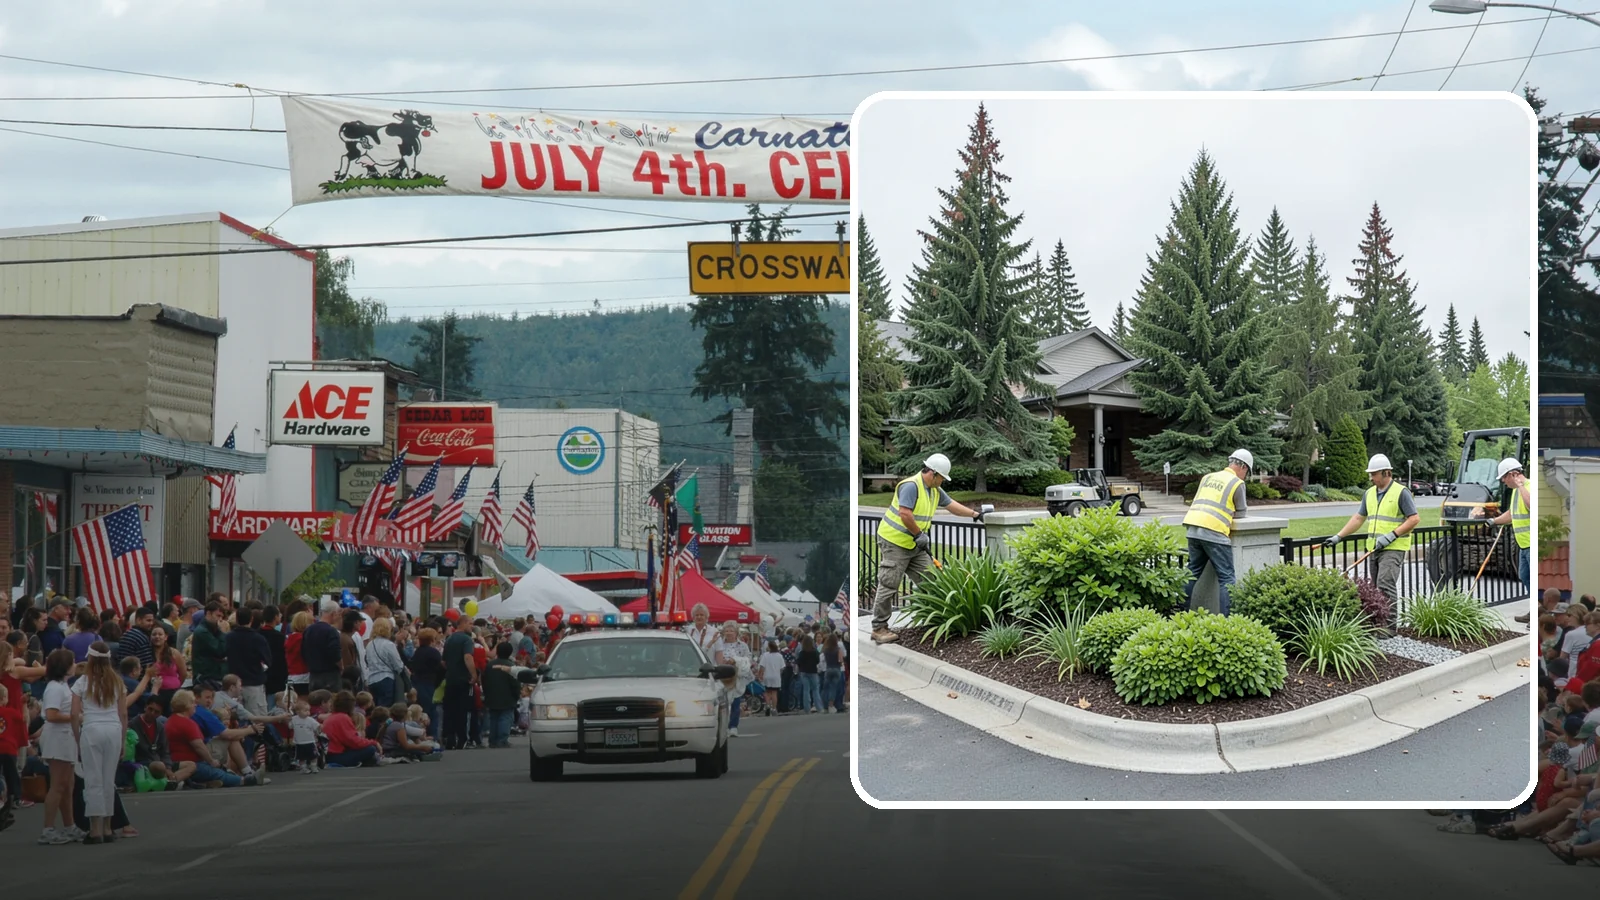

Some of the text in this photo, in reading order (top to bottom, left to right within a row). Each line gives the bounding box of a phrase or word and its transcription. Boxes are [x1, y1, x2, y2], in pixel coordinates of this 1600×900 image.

[695, 121, 850, 150] Carnat
[481, 140, 605, 192] JULY
[632, 150, 746, 198] 4th.
[696, 254, 850, 280] CROSSWA
[282, 380, 373, 420] ACE
[405, 409, 453, 422] CEDAR
[283, 421, 371, 437] Hardware
[416, 428, 477, 447] Coca-Cola
[353, 467, 386, 481] Simpl
[96, 485, 124, 495] Vincent
[126, 486, 136, 494] de
[138, 486, 155, 495] Paul
[688, 526, 741, 535] CRNATION
[699, 535, 730, 543] GLASS
